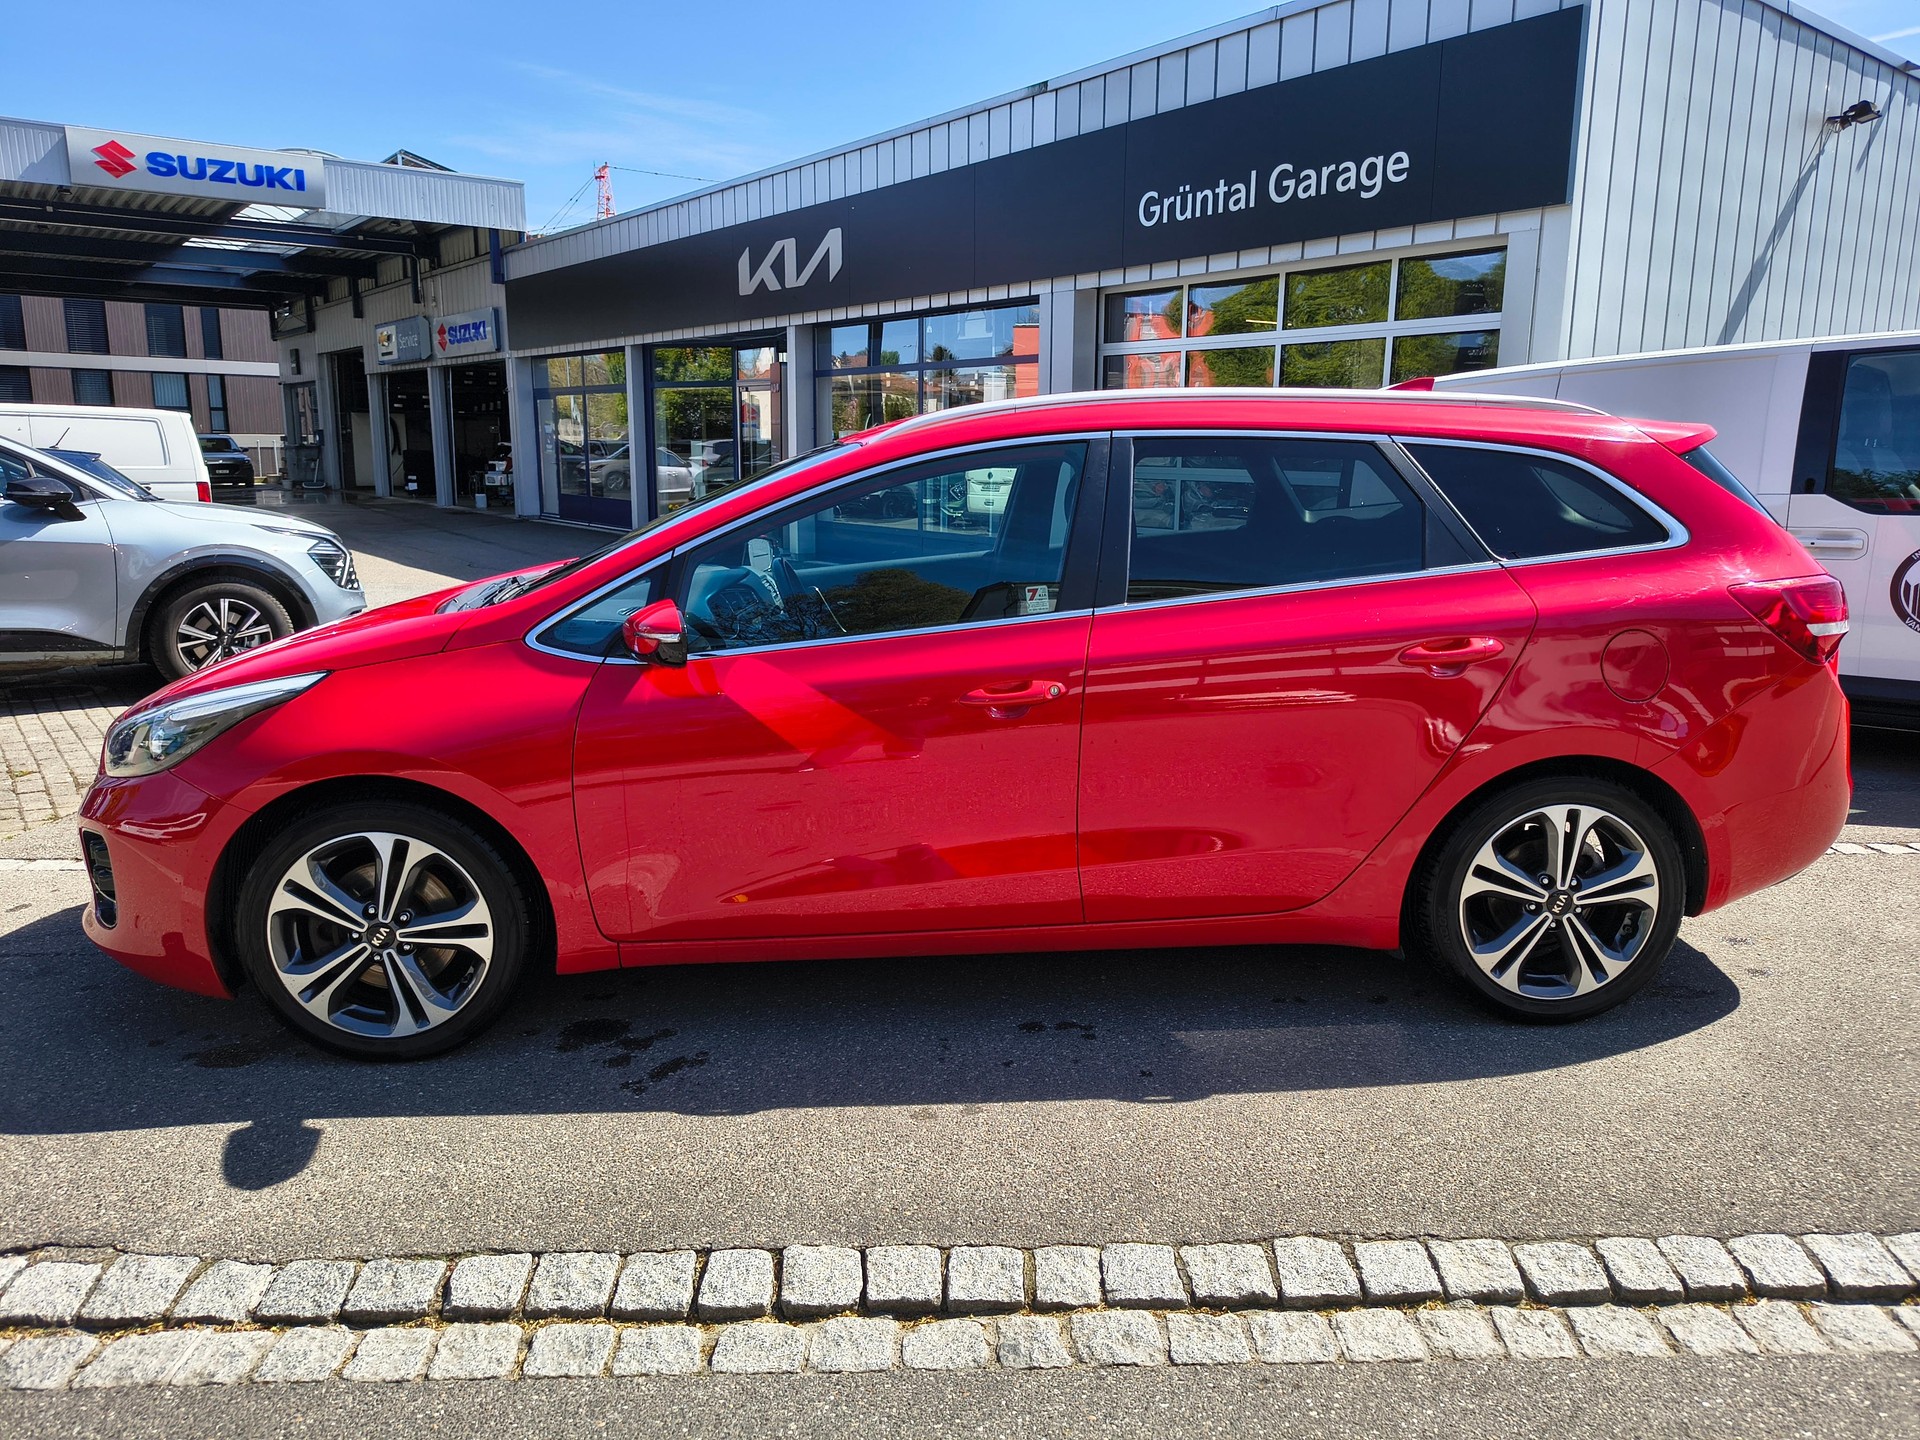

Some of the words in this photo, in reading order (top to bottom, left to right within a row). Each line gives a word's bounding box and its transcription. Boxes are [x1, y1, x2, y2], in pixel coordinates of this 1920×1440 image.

[146, 152, 306, 192] SUZUKI
[1138, 170, 1256, 227] Grüntal
[1268, 151, 1410, 204] Garage
[738, 227, 843, 296] KIA
[448, 320, 488, 345] SUZUKI
[1551, 895, 1568, 913] KIA
[371, 927, 390, 946] KIA
